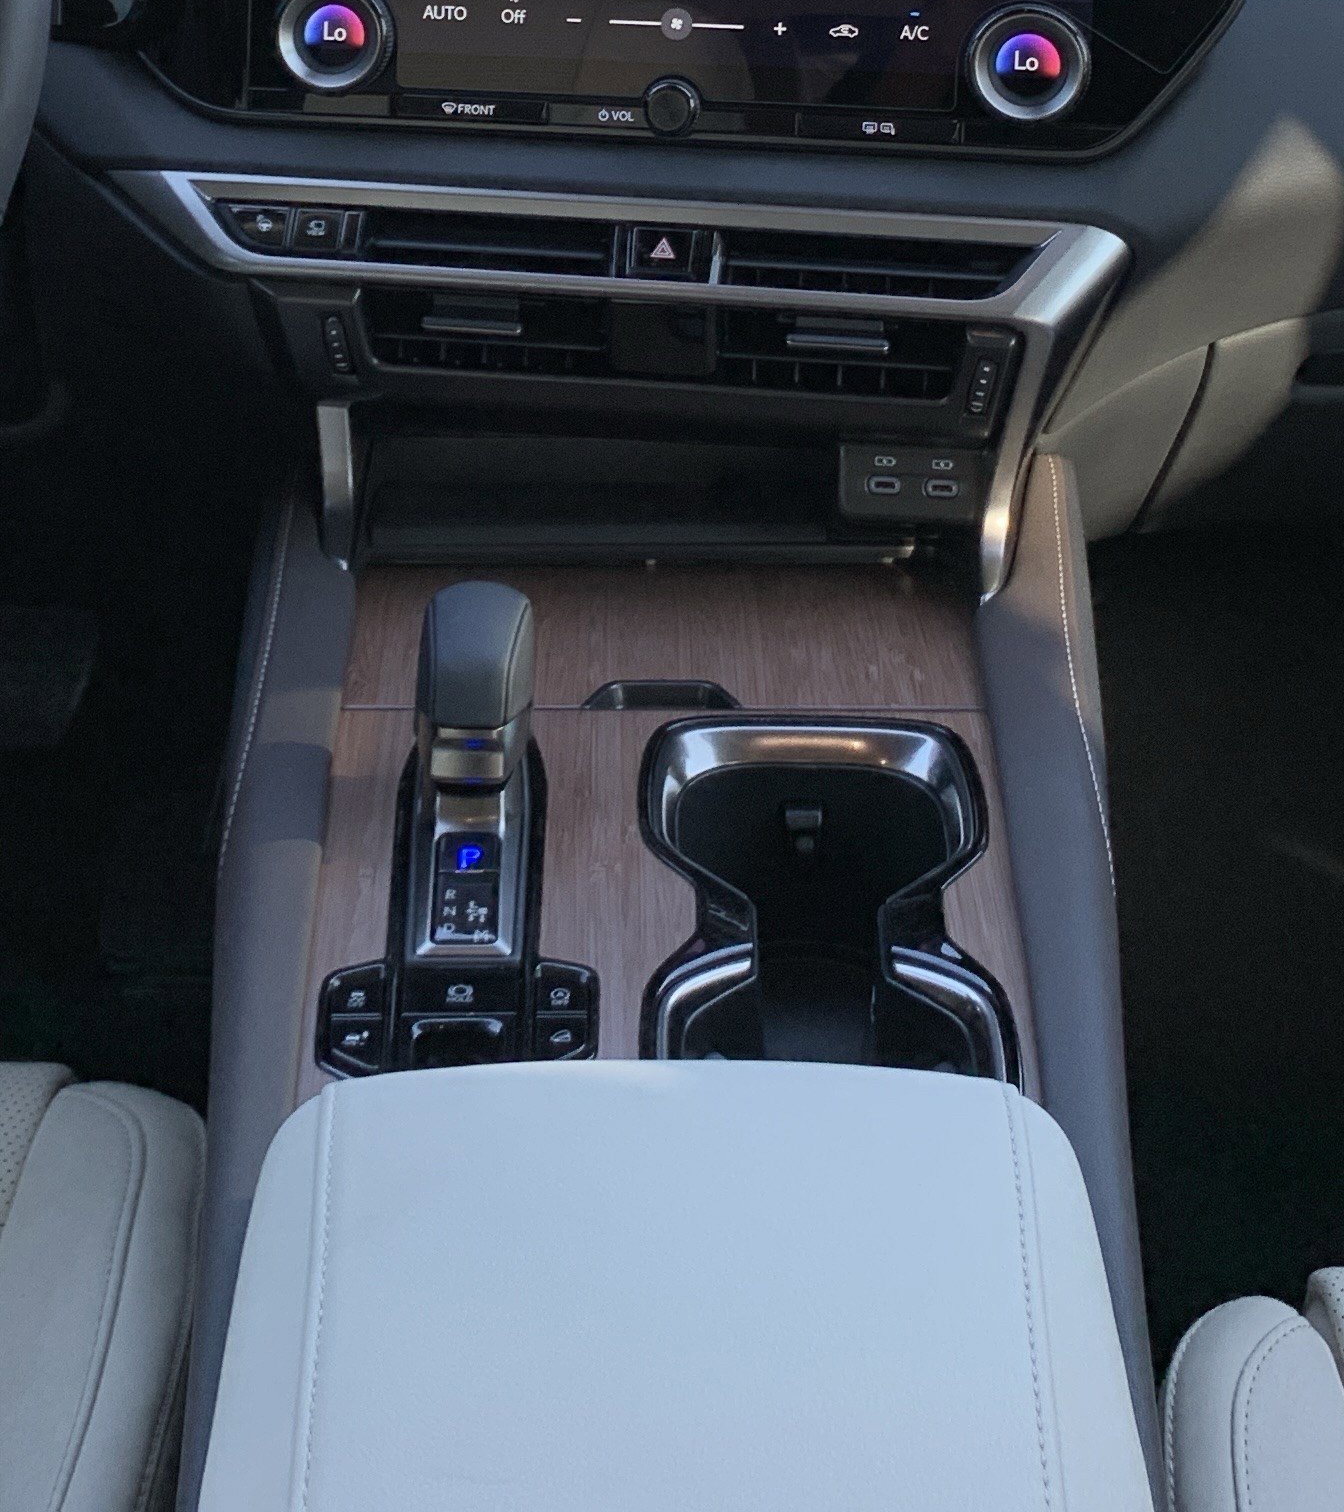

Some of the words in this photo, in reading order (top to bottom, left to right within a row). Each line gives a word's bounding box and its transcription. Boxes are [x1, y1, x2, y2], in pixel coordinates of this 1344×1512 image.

[323, 20, 347, 43] Lo
[422, 4, 468, 22] AUTO
[500, 8, 527, 25] Off
[899, 24, 930, 42] A/C
[1013, 50, 1039, 73] Lo
[457, 103, 496, 117] FRONT
[611, 110, 635, 122] VOL
[459, 847, 483, 869] P
[444, 888, 457, 900] R
[442, 905, 457, 917] N
